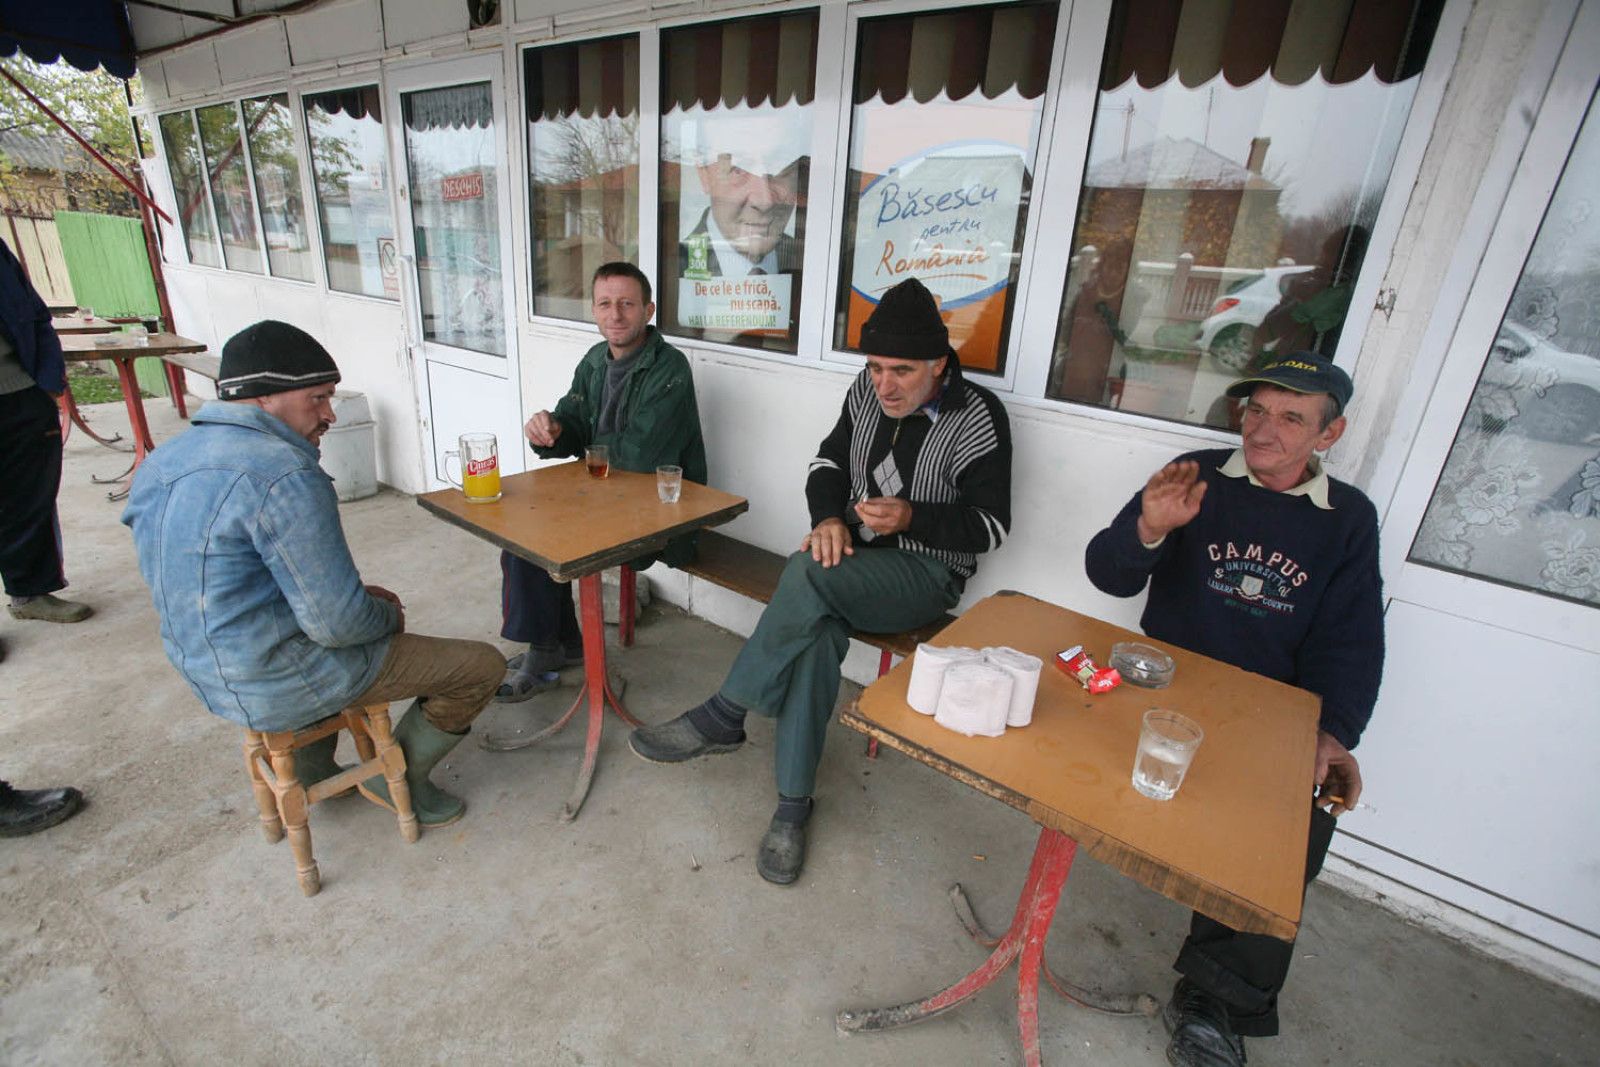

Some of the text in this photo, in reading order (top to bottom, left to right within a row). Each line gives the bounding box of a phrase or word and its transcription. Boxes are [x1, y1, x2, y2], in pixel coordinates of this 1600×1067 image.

[444, 175, 481, 198] DESCHIS
[877, 182, 998, 228] Băsescu
[914, 218, 981, 252] pentru
[690, 259, 707, 269] 300
[875, 239, 991, 276] România
[695, 279, 772, 297] De ce le e frică,
[731, 300, 744, 311] nu
[1208, 541, 1308, 587] CAMPUS
[1225, 561, 1286, 587] UNIVERSITY
[1263, 598, 1295, 613] COUNTY
